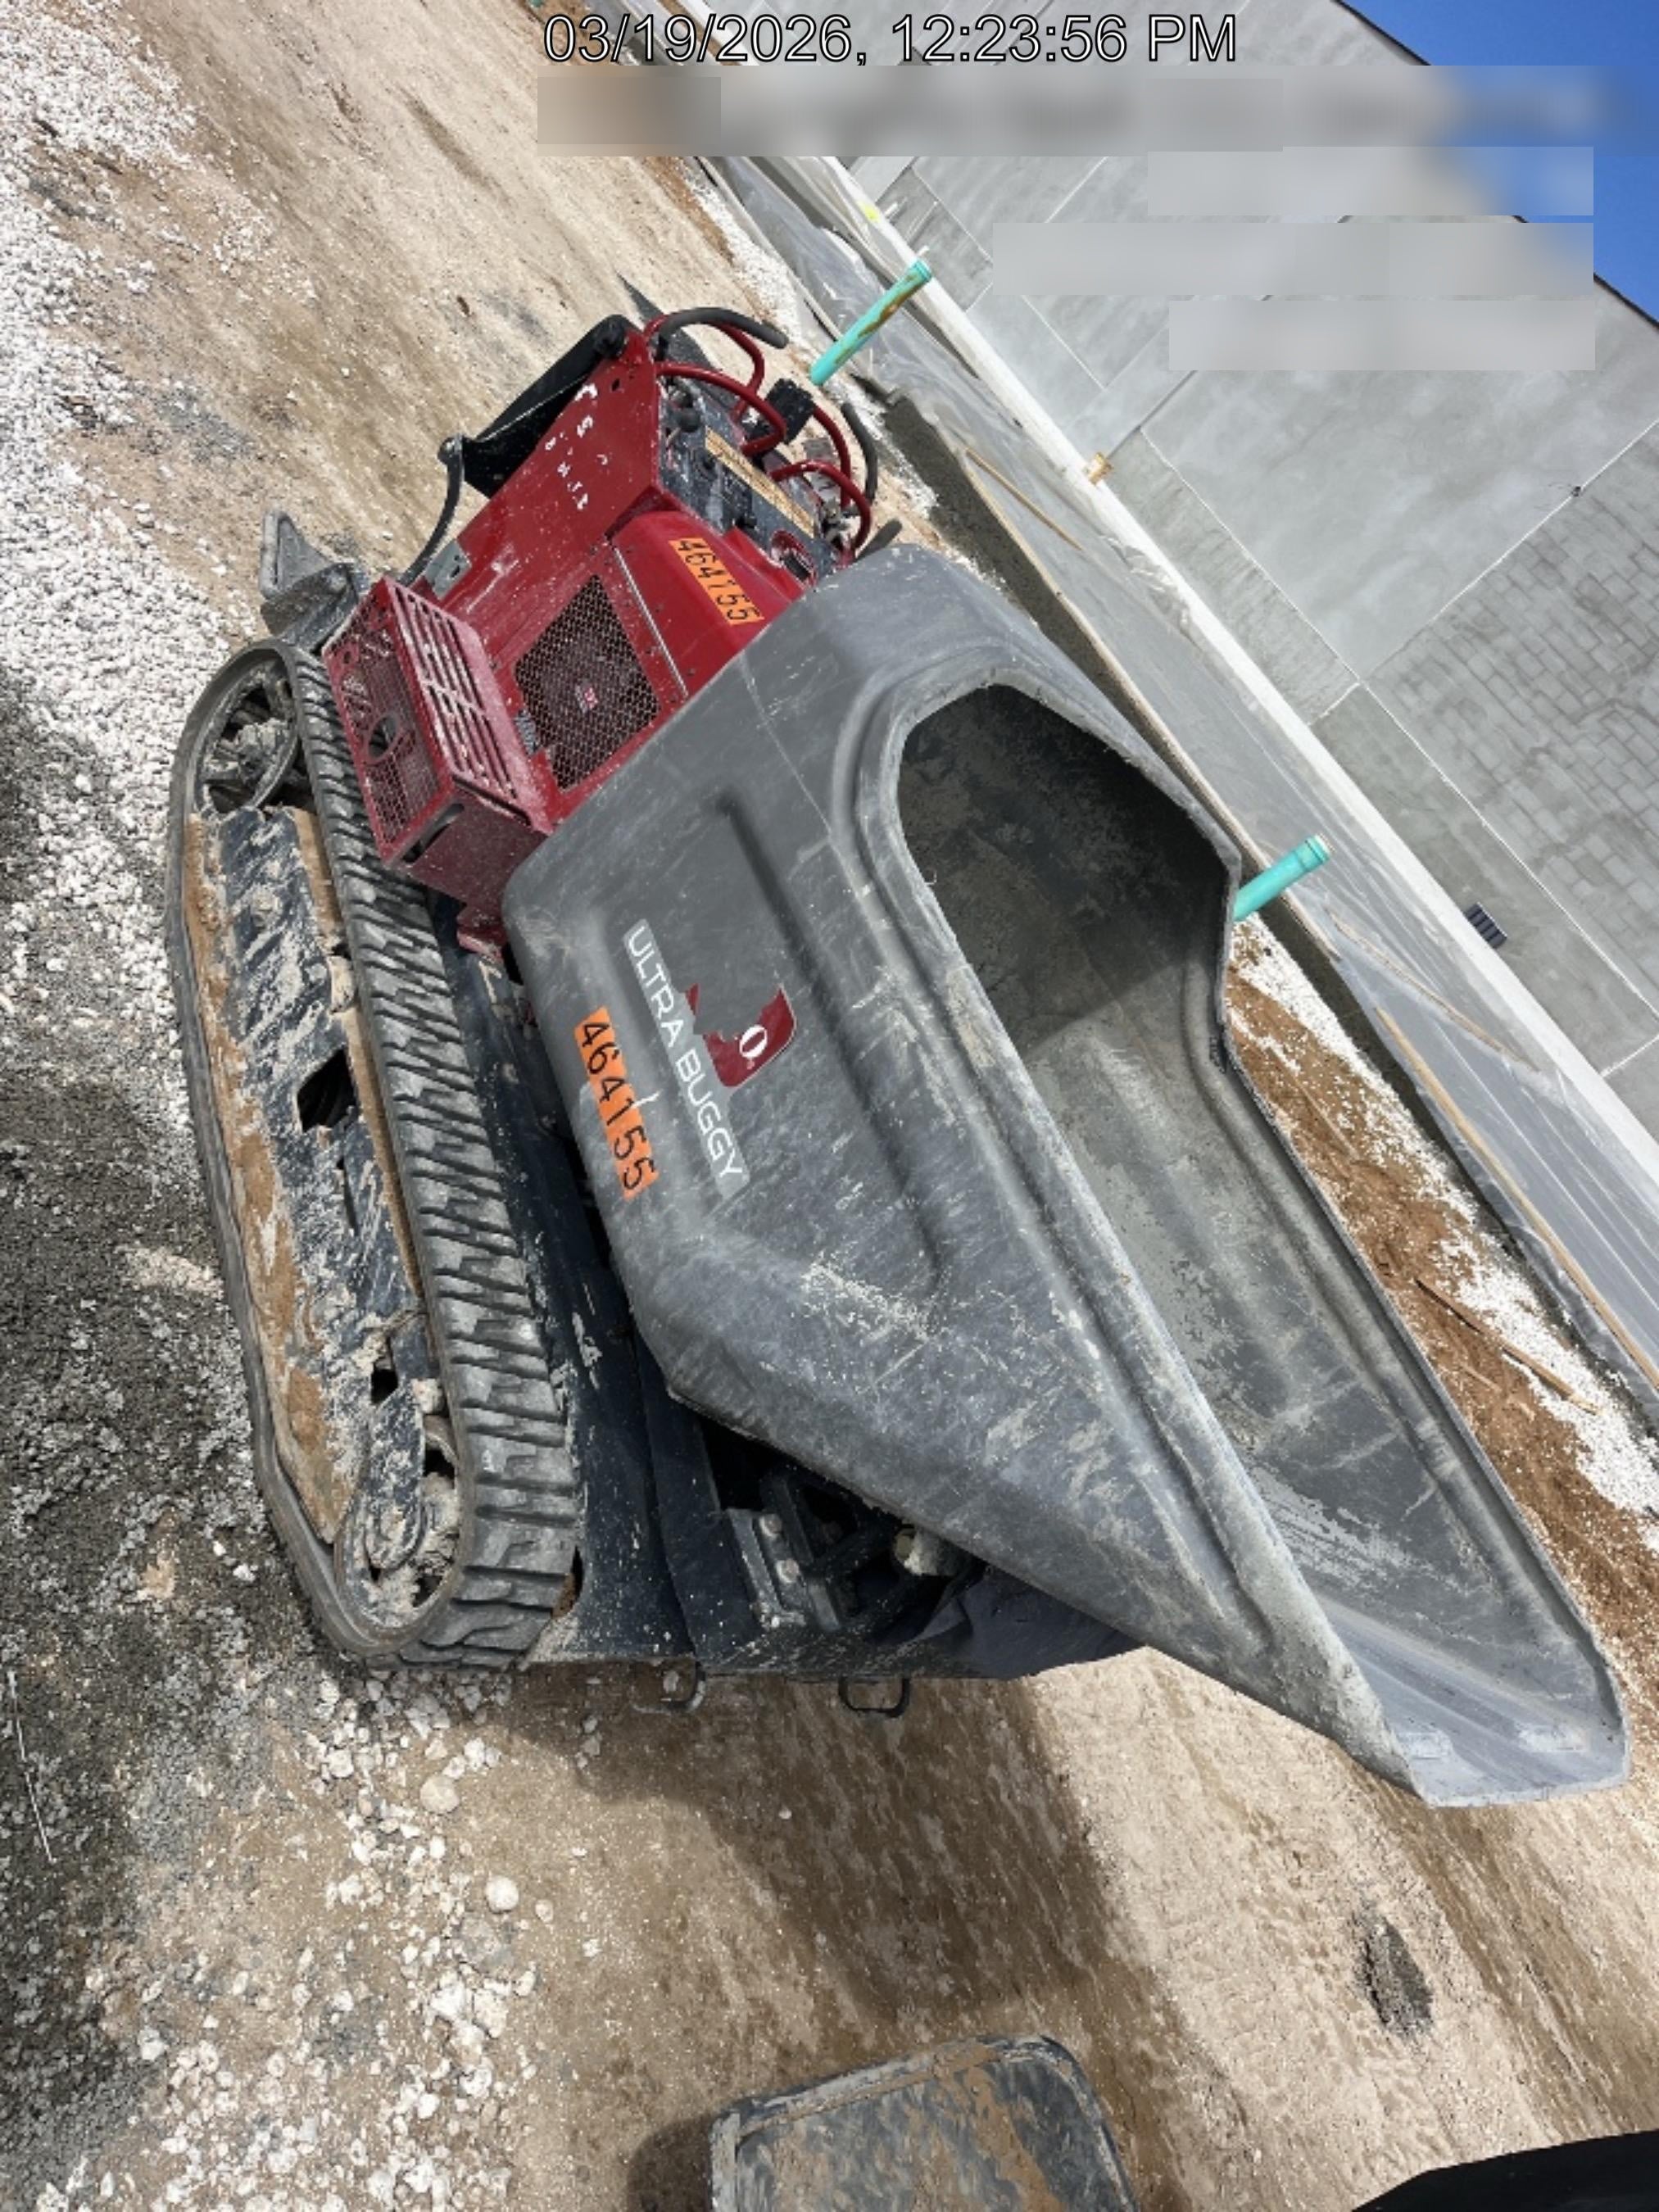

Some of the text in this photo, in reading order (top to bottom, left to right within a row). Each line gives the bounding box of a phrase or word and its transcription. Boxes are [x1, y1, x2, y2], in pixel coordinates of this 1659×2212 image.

[677, 539, 761, 621] 464155
[581, 1022, 656, 1190] 464155
[628, 925, 743, 1178] ULTRA BUGGY
